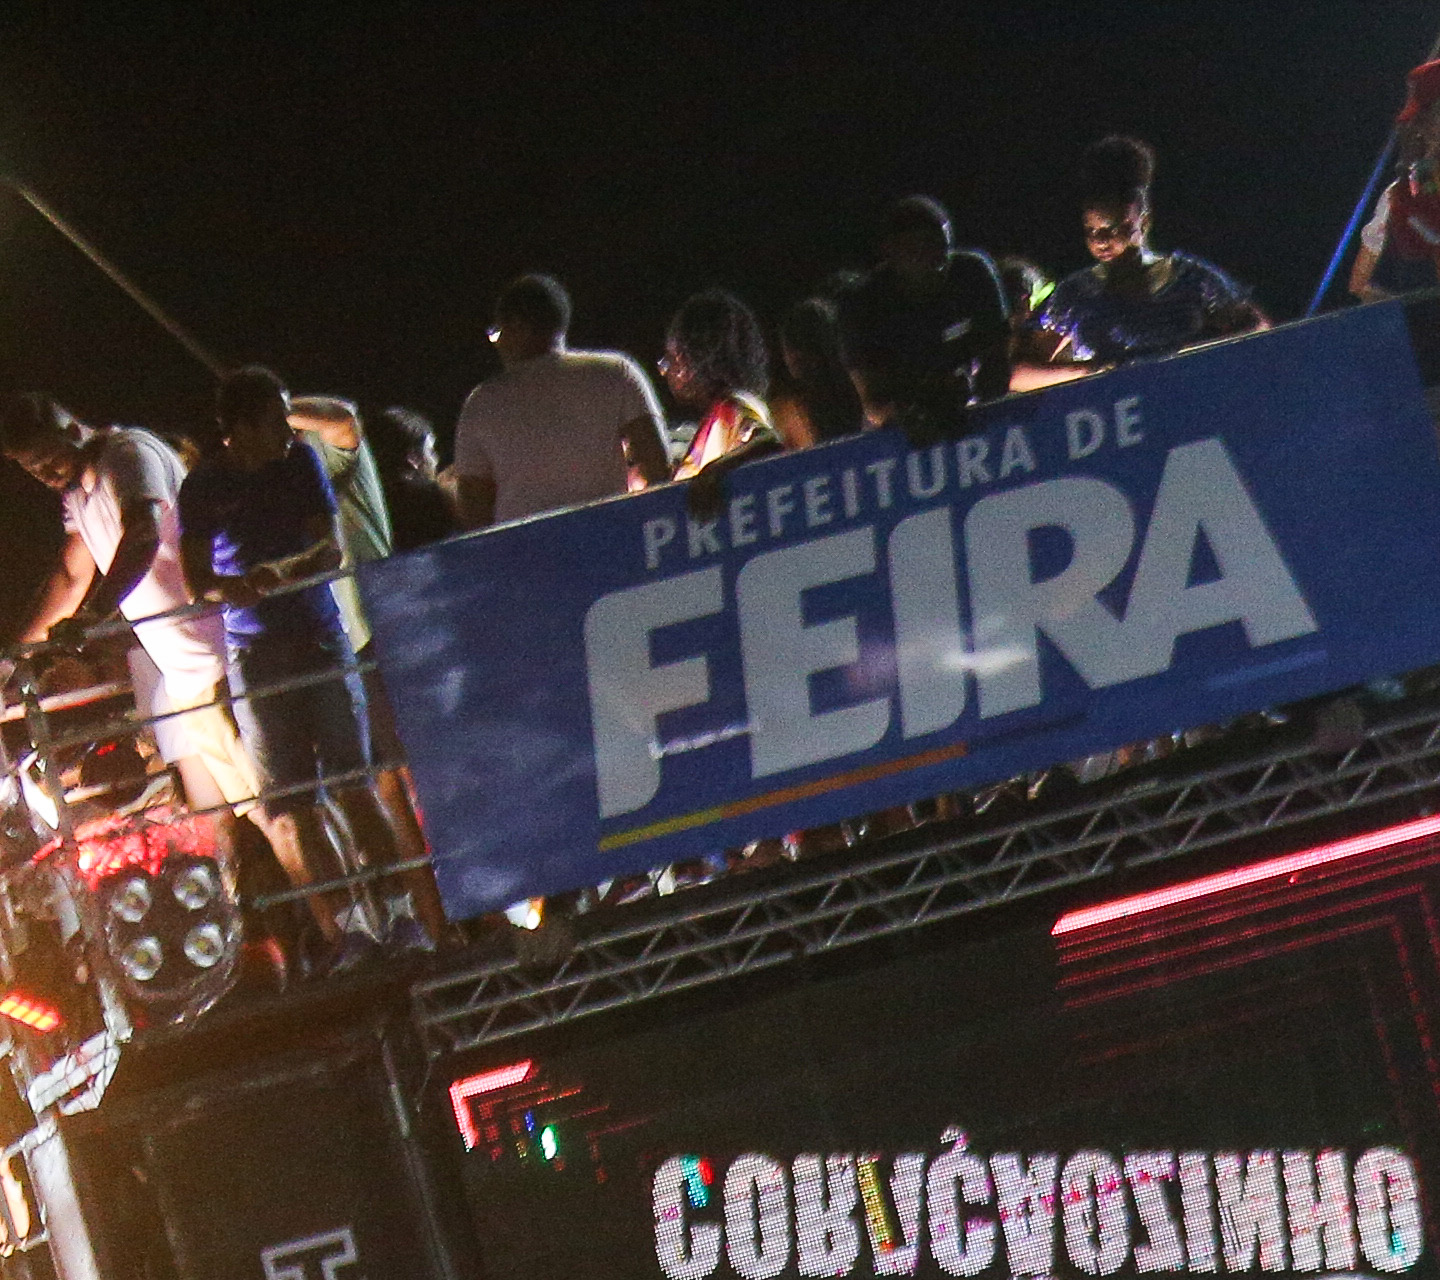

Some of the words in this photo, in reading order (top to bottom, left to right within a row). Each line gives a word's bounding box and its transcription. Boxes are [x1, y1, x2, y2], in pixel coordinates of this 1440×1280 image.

[643, 426, 1037, 570] PREFEITURA
[1066, 397, 1143, 460] DE
[583, 436, 1318, 820] FEIRA
